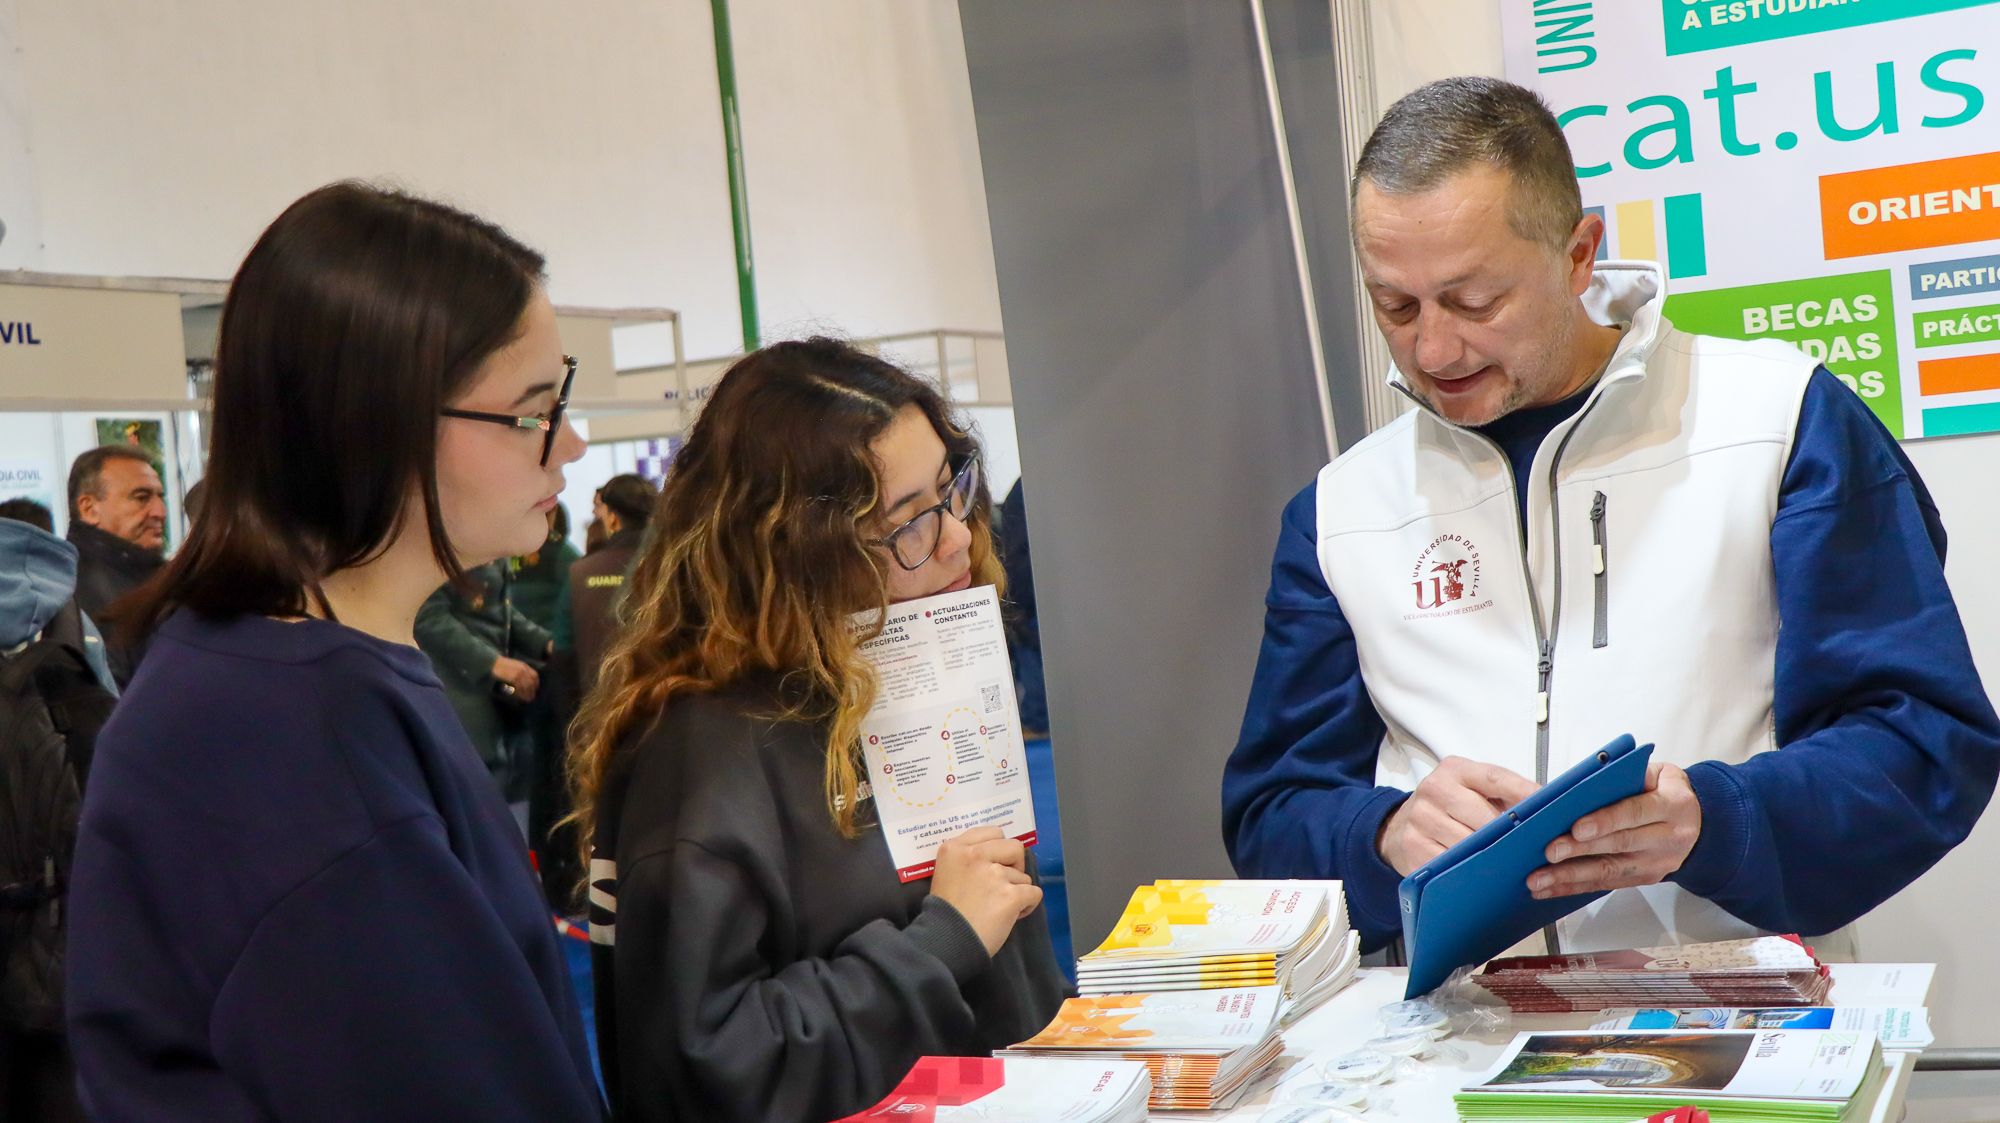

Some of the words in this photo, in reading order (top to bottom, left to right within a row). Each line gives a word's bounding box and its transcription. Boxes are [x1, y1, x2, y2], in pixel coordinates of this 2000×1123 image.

[1682, 10, 1702, 30] A
[1710, 0, 1860, 26] ESTUD
[1533, 0, 1597, 74] UNI
[1920, 265, 2000, 292] PARTI
[1743, 294, 1878, 334] BECAS
[1413, 534, 1462, 578] UNIVERSIDAD
[1463, 540, 1475, 551] DE
[1470, 552, 1480, 597] SEVILLA
[908, 613, 919, 621] DE
[932, 599, 991, 616] ACTUALIZACIONES
[934, 611, 978, 625] CONSTANTES
[1453, 608, 1461, 616] DE
[1462, 599, 1494, 615] ESTUDIANTES
[897, 823, 927, 835] Estudiar
[920, 826, 953, 838] cat.us.es
[1755, 1033, 1786, 1058] Sevilla
[1092, 1071, 1114, 1092] BECAS
